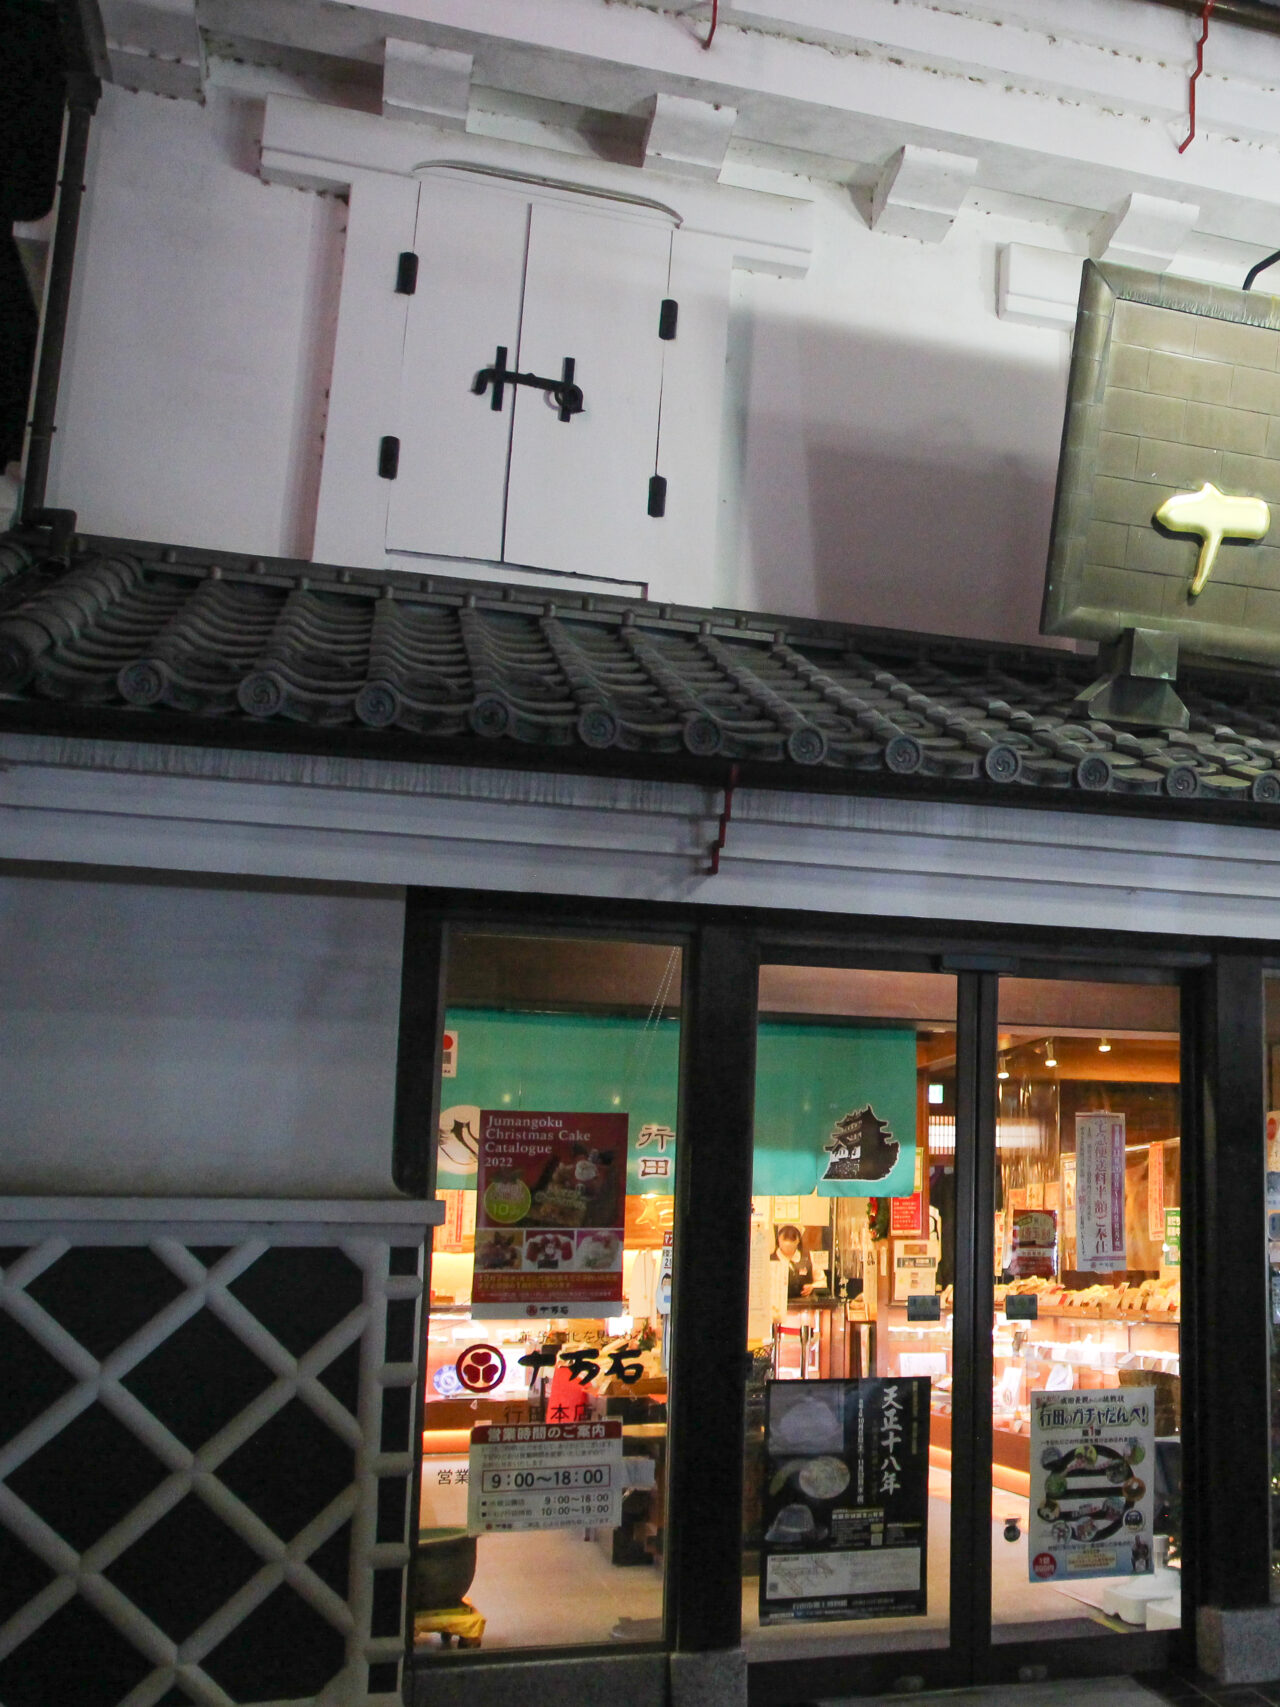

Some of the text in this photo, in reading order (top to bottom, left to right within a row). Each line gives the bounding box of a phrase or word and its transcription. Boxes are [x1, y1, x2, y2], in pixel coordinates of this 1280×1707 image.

[487, 1115, 563, 1130] Jumangoku
[485, 1128, 591, 1142] Christmas Cake
[484, 1142, 553, 1156] Catalogue
[637, 1125, 676, 1178] 行田
[484, 1157, 513, 1167] 2022
[518, 1344, 644, 1385] 十万石
[487, 1424, 606, 1442] 営業時間のご案内
[879, 1385, 903, 1496] 天正十八年
